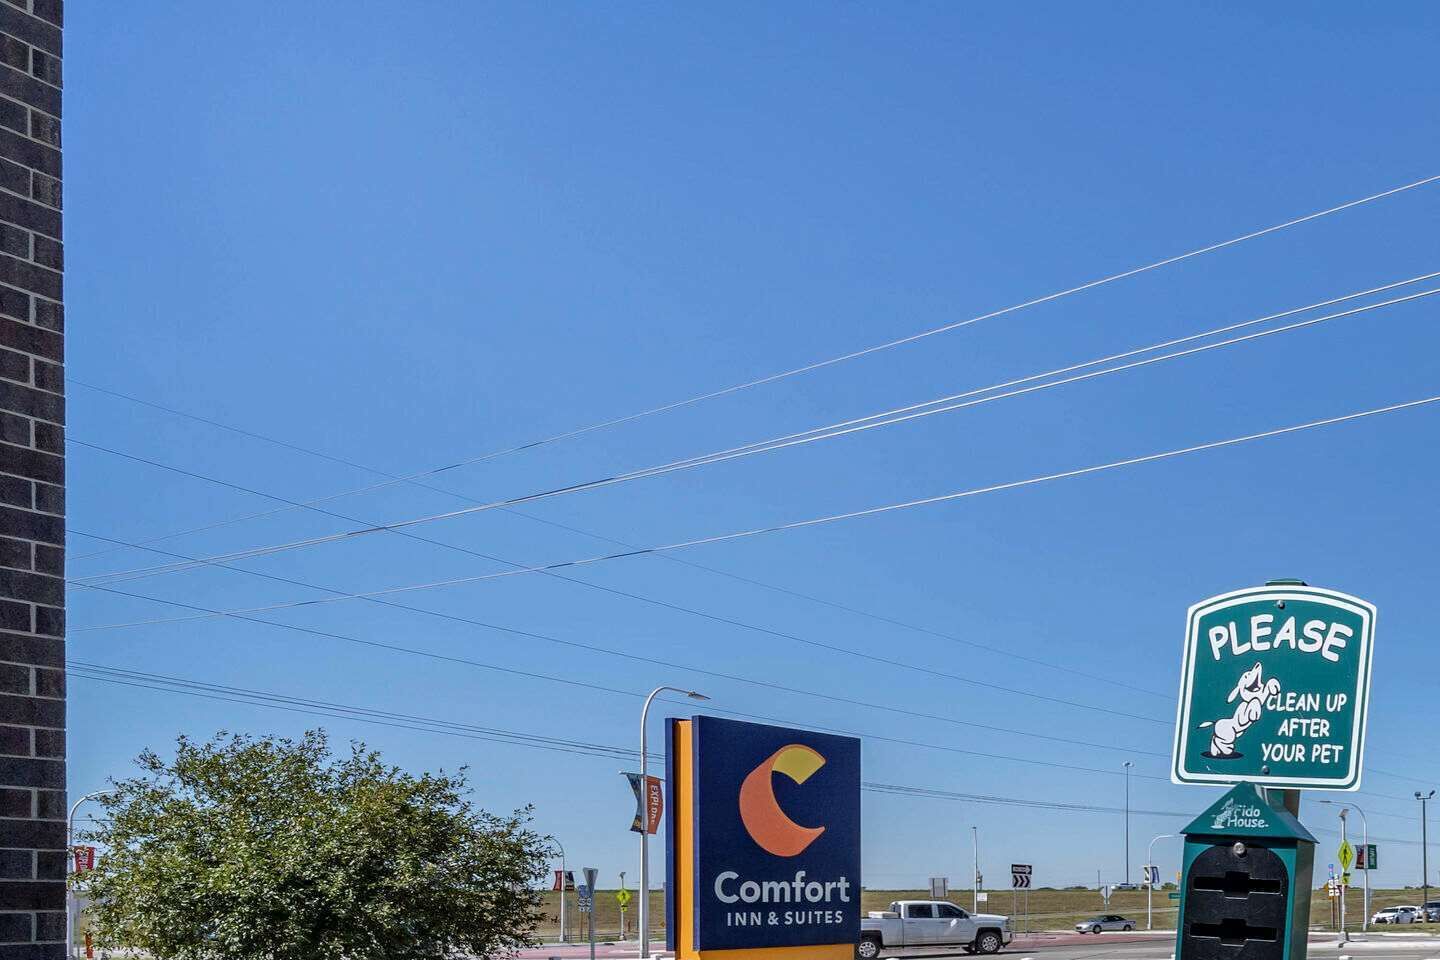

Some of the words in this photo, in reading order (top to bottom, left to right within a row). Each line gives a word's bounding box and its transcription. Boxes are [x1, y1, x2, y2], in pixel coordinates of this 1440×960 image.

[1208, 613, 1354, 662] PLEASE
[1266, 692, 1320, 712] CLEAN
[1326, 693, 1348, 712] UP
[1277, 718, 1330, 738] AFTER
[1261, 742, 1305, 762] YOUR
[1311, 744, 1344, 764] PET
[1233, 804, 1261, 817] Fido
[714, 870, 850, 904] Comfort
[727, 911, 762, 927] INN
[767, 911, 779, 926] &
[784, 910, 844, 925] SUITES
